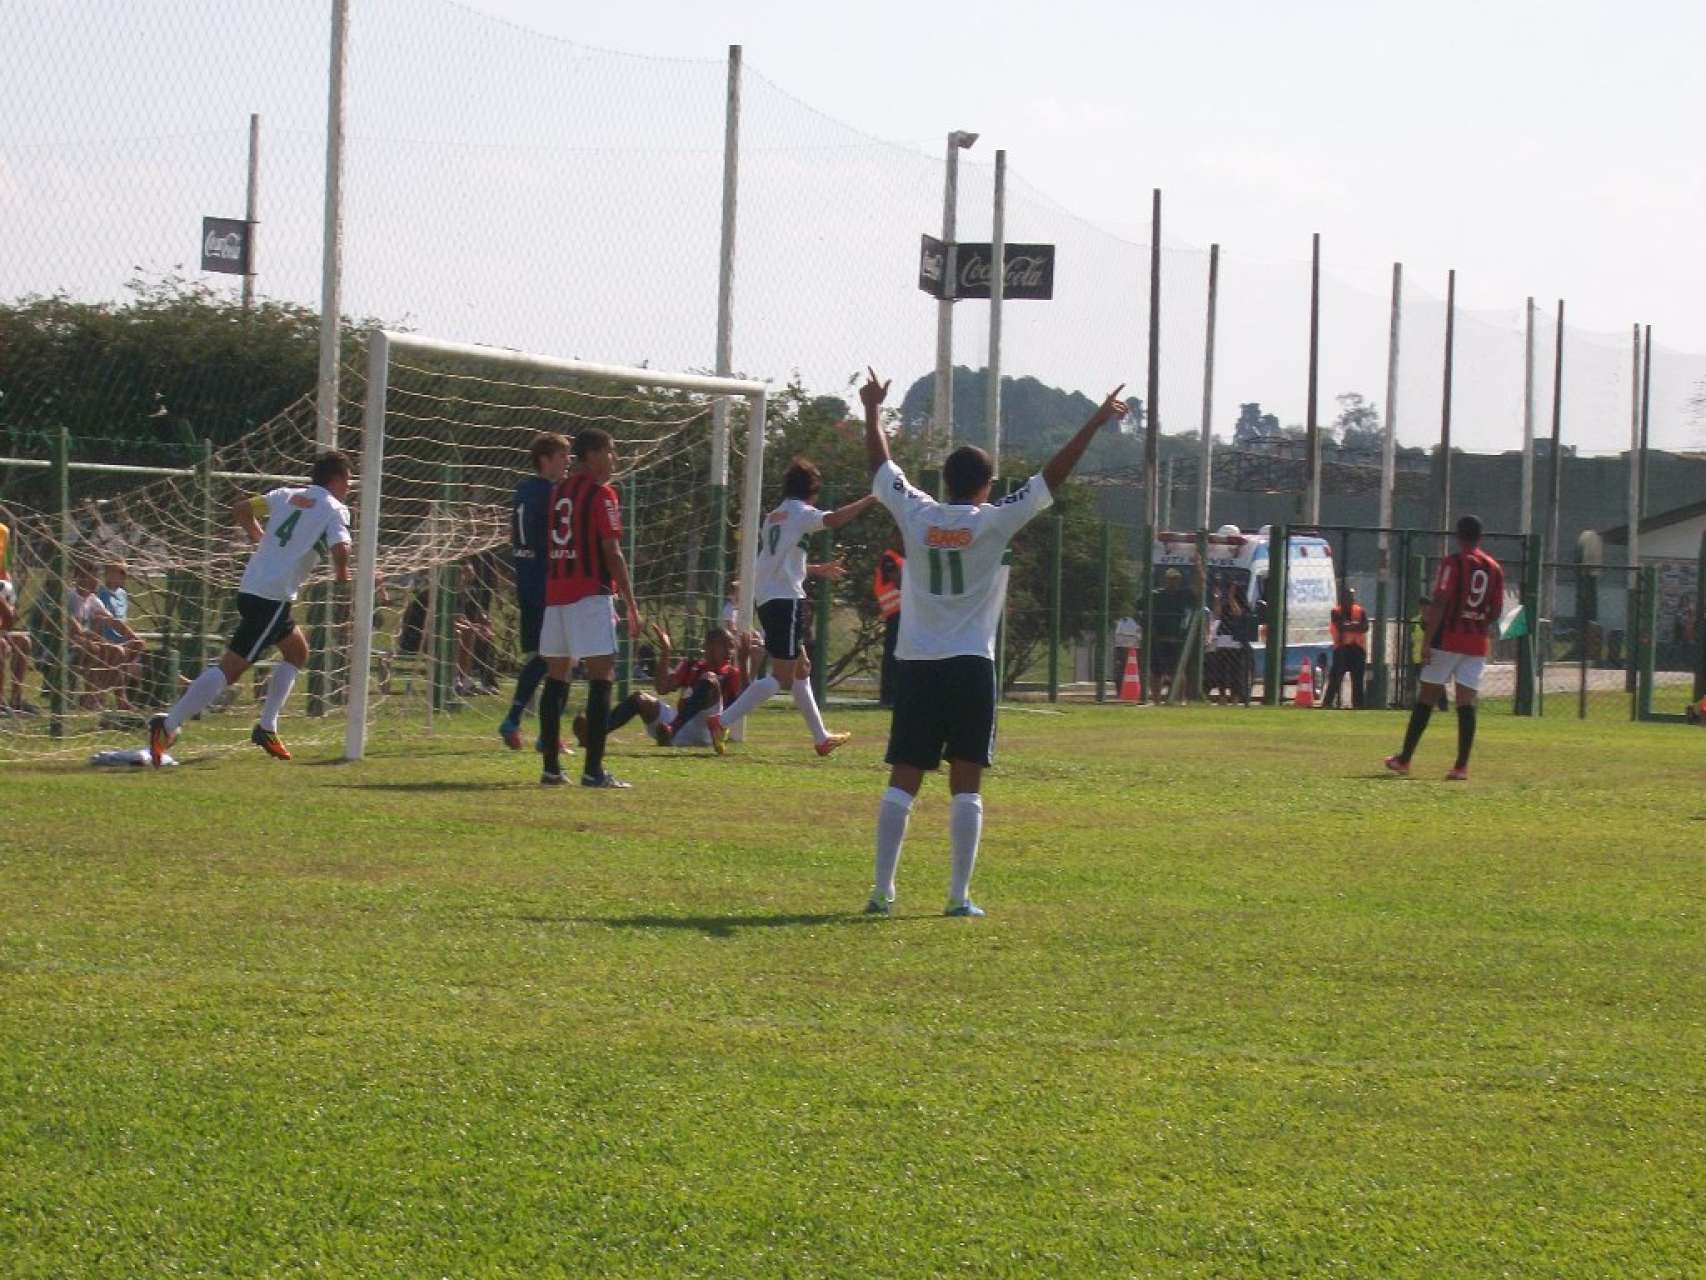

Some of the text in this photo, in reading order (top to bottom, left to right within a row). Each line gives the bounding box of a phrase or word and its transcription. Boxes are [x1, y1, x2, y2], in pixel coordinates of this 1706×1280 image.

[275, 509, 302, 547] 4
[515, 503, 528, 546] 1
[551, 497, 573, 545] 3
[928, 549, 963, 595] 11
[1468, 569, 1489, 608] 9
